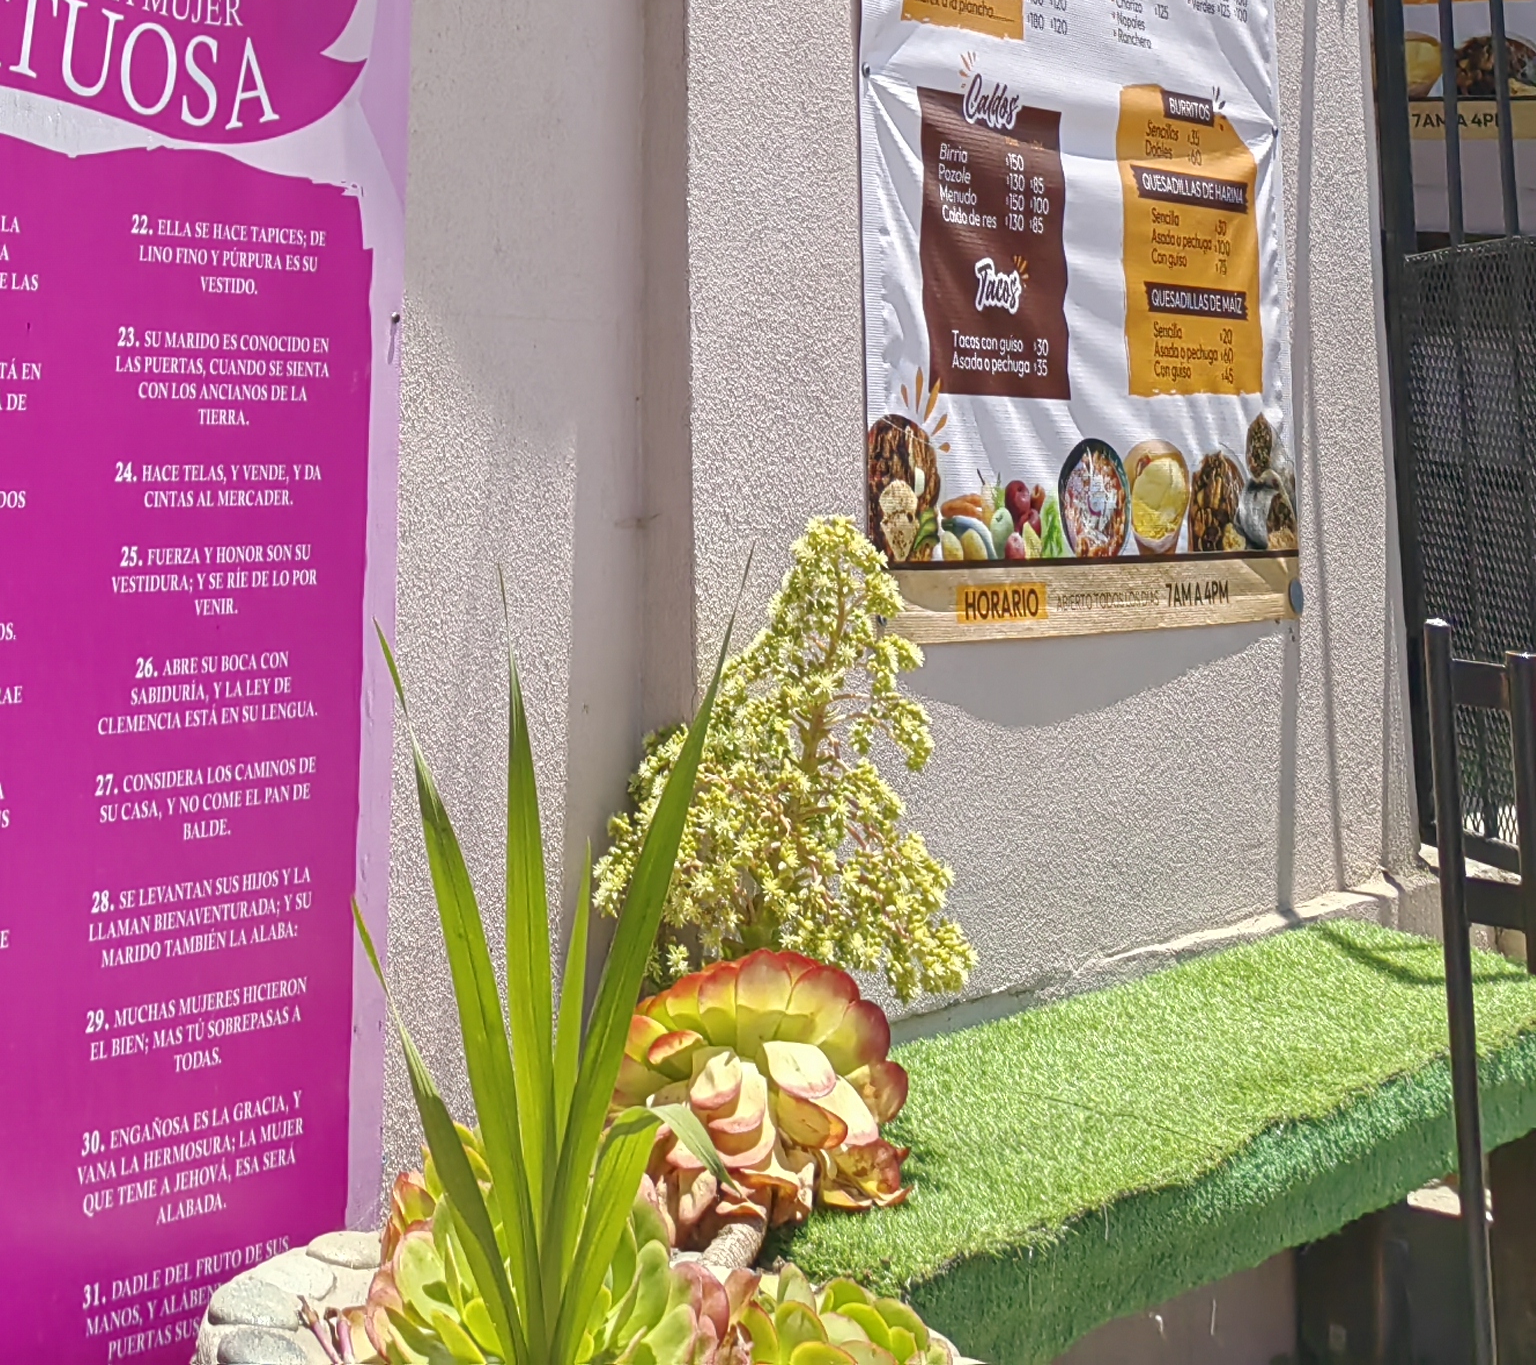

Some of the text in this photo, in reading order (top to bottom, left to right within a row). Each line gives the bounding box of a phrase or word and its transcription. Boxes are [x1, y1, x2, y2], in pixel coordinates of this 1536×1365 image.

[965, 73, 1020, 127] Caldos
[1169, 97, 1210, 121] BURRITOS
[939, 143, 968, 163] Birria
[939, 164, 971, 184] Pozole
[1142, 173, 1201, 198] QUESADILLAS
[1202, 182, 1214, 199] DE
[939, 184, 977, 205] Menudo
[1, 216, 20, 233] LA
[942, 204, 967, 226] Caldo
[969, 210, 981, 226] de
[982, 216, 997, 228] res
[131, 214, 325, 247] 22. ELLA SE HACE TAPICES; DE
[140, 245, 317, 272] LINO FINO Y PÚRPURA ES SU
[12, 273, 38, 291] LAS
[201, 276, 257, 294] VESTIDO.
[976, 260, 1020, 311] Tacos
[1151, 289, 1243, 314] QUESADILLAS DE MAÍZ
[952, 330, 980, 350] Tacos
[981, 337, 998, 351] con
[999, 336, 1024, 355] guiso
[952, 351, 983, 371] Asada
[984, 359, 990, 370] o
[991, 356, 1030, 377] pechuga
[965, 588, 1039, 621] HORARIO
[1165, 581, 1192, 607] 7AM
[1194, 583, 1203, 605] A
[1204, 579, 1229, 604] 4PM
[85, 977, 306, 1033] 29. MUCHAS MUJERES HICIERON
[90, 1005, 301, 1061] EL BIEN; MAS TÚ SOBREPASAS A
[174, 1047, 221, 1072] TODAS.
